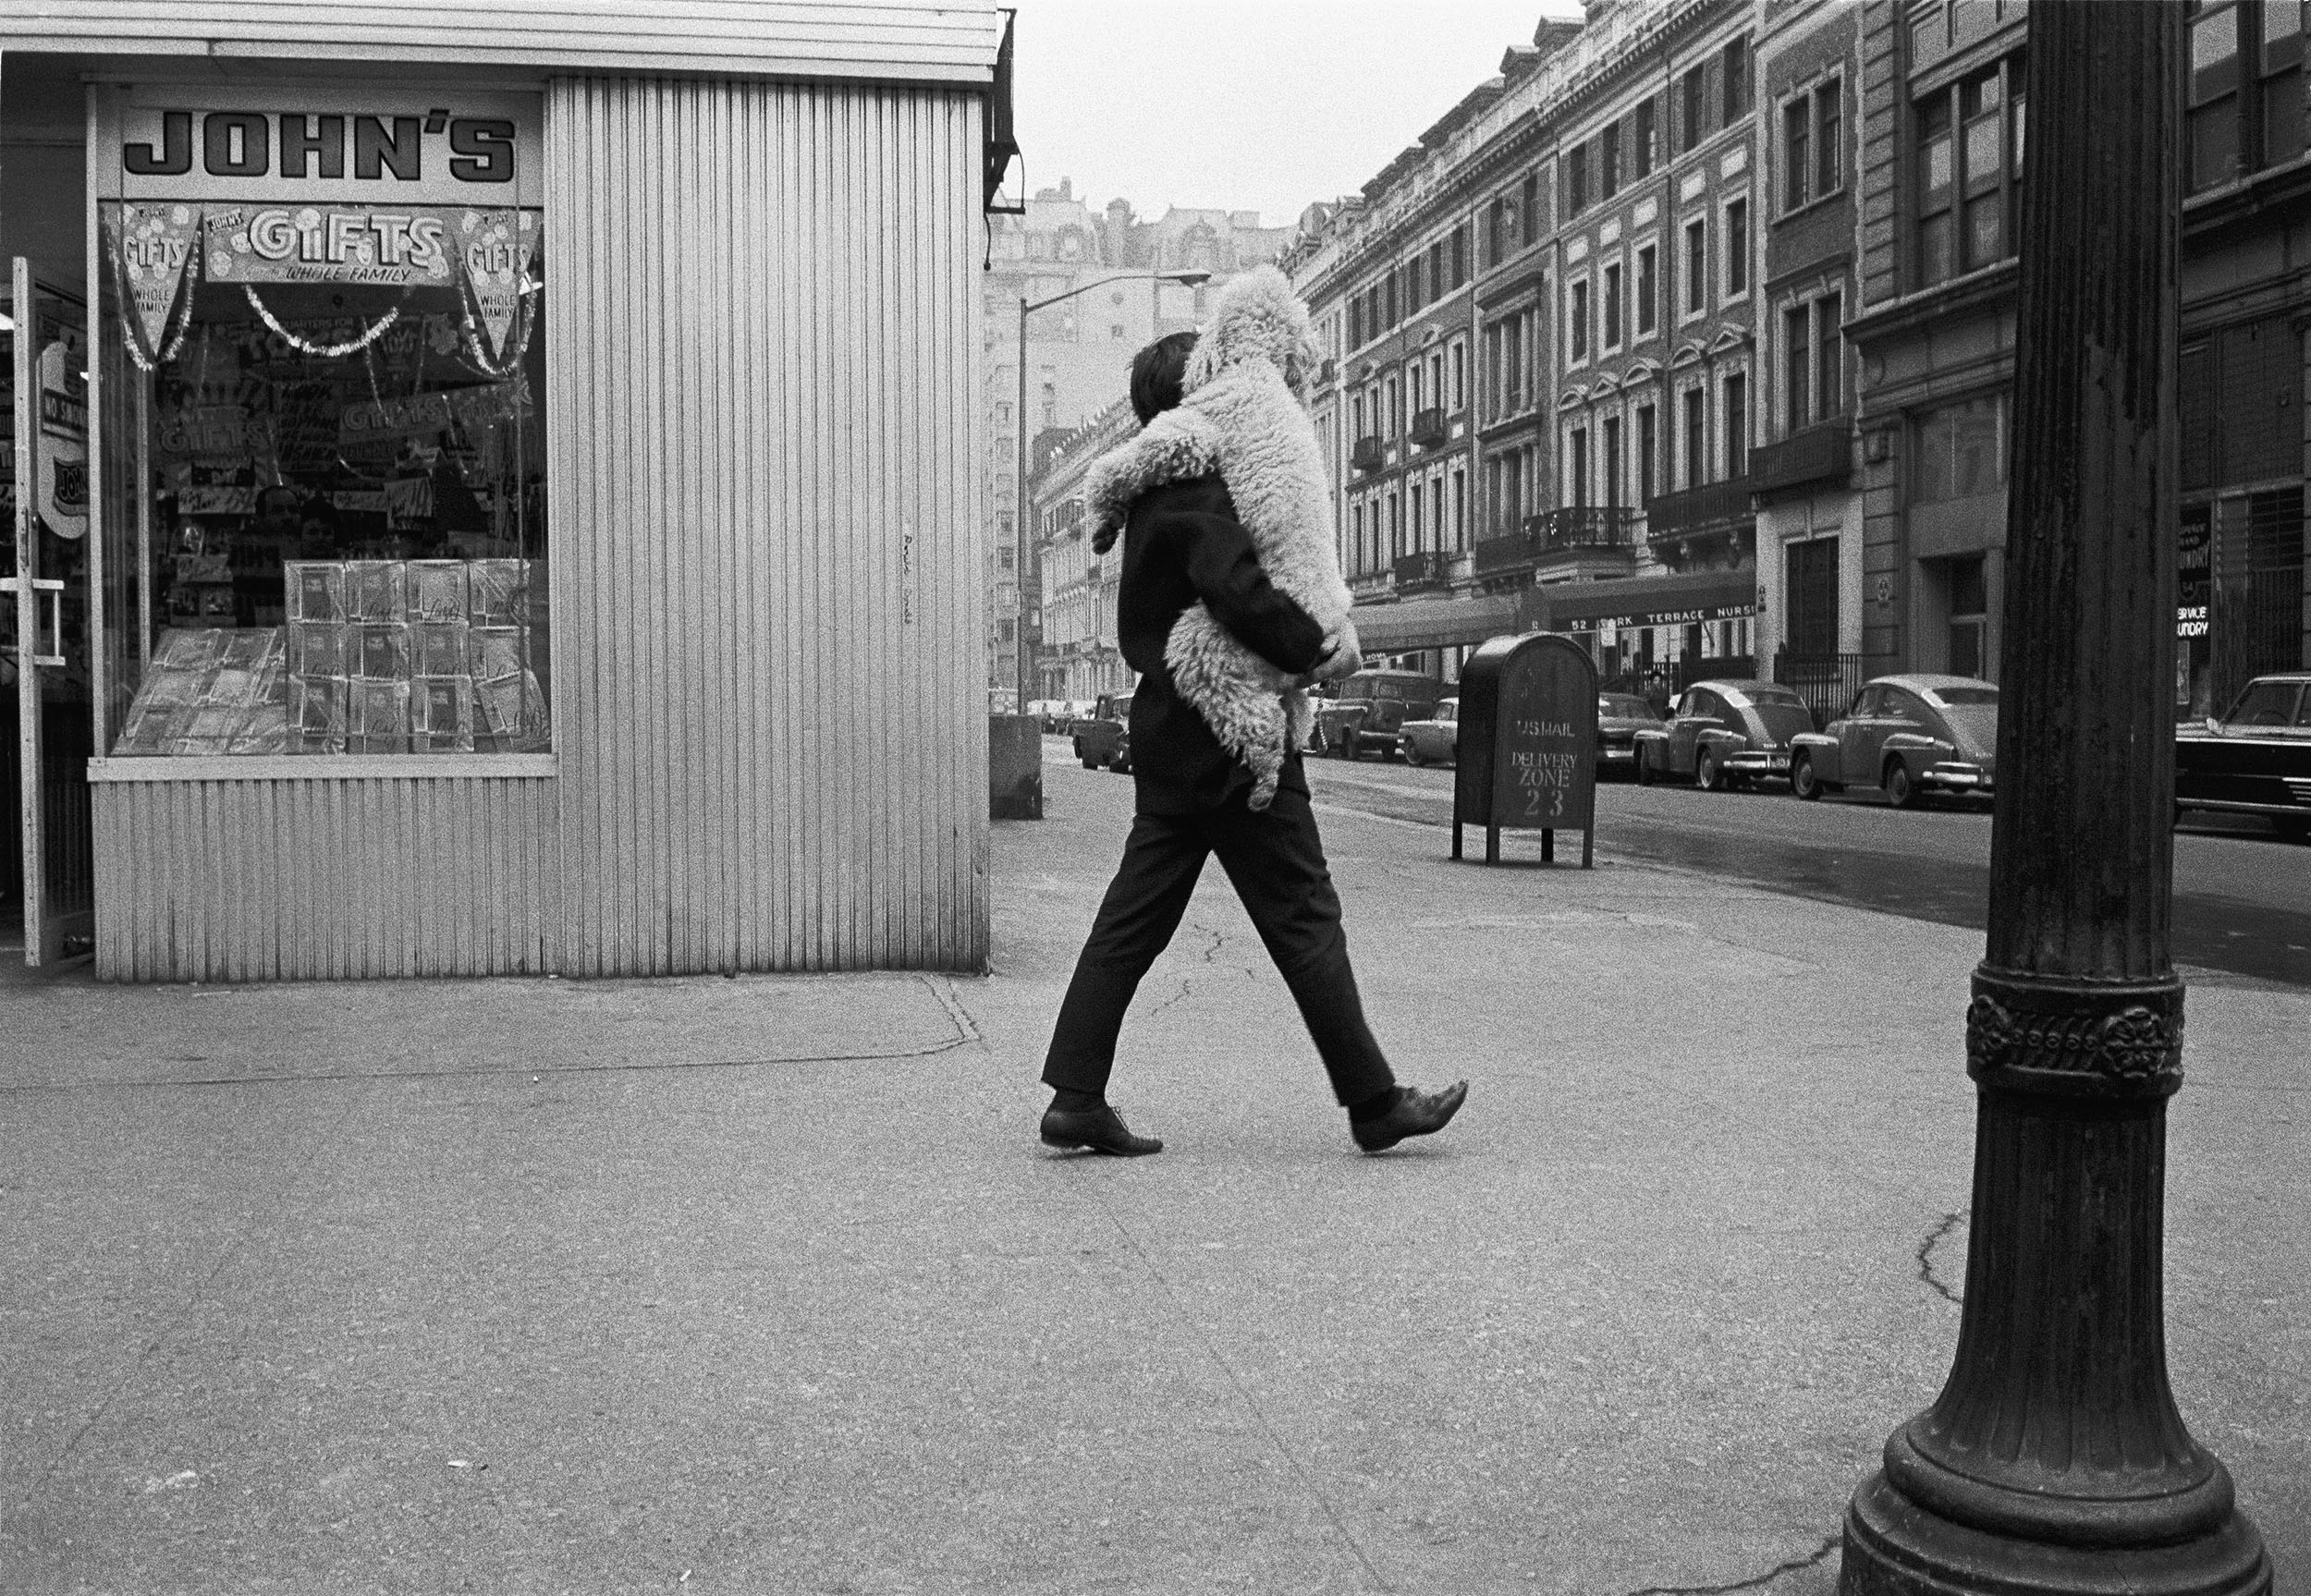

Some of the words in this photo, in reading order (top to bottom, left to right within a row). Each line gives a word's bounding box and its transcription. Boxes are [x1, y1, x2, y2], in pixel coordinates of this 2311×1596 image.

[124, 109, 516, 182] JOHN'S
[287, 266, 346, 281] WHOLE
[348, 267, 411, 283] FAMILY
[1571, 620, 1586, 630] 52
[1646, 609, 1705, 624] TERRACE
[1511, 751, 1578, 769] DELIVERY
[1519, 767, 1571, 788] ZONE
